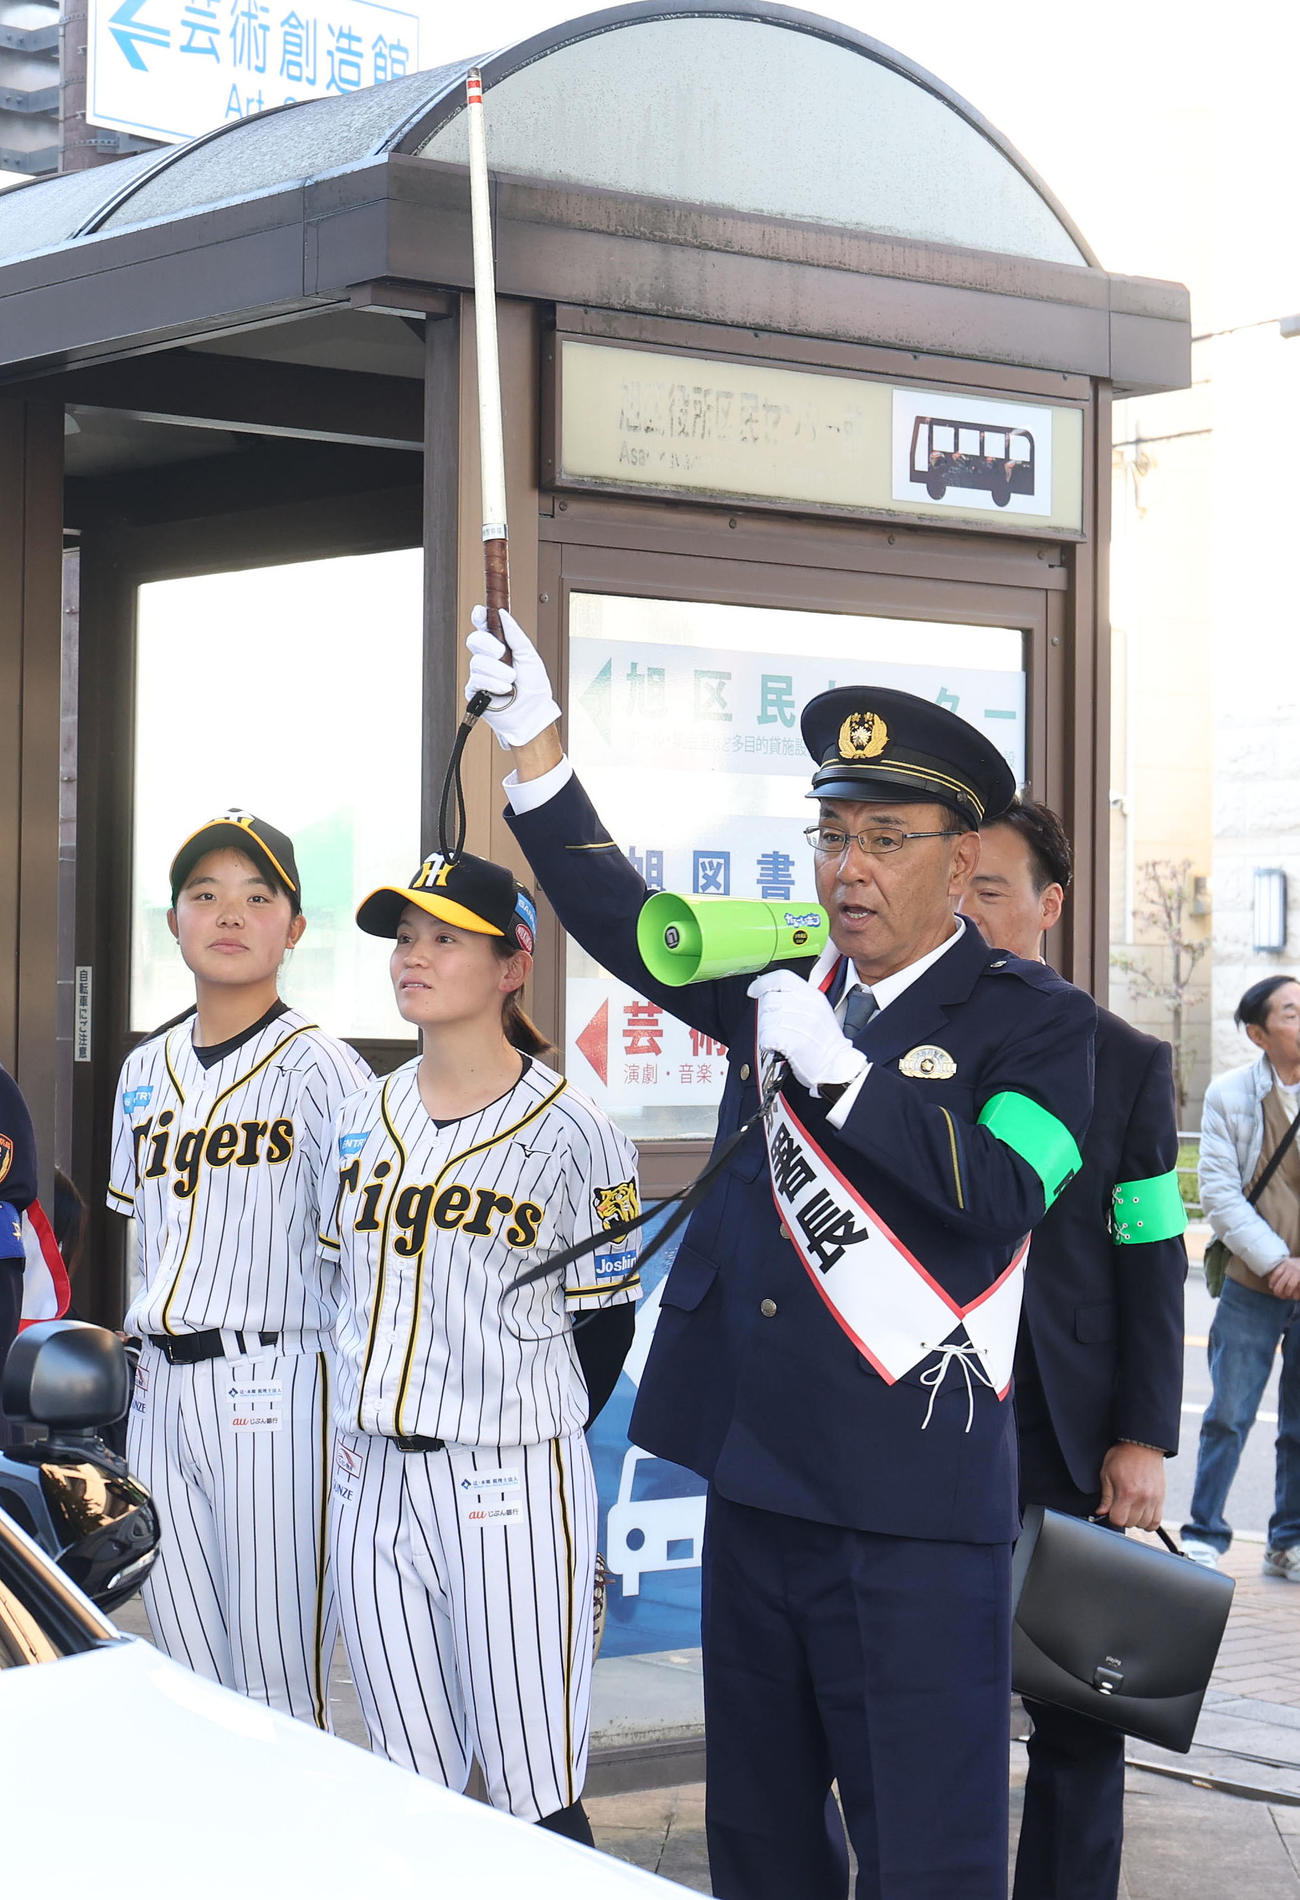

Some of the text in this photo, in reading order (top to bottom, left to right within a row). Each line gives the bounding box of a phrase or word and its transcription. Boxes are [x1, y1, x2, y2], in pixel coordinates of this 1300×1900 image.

[180, 0, 409, 94] 芸術創造館
[134, 1110, 294, 1198] Tigers
[339, 1159, 543, 1257] Tigers
[232, 1417, 249, 1426] au
[468, 1511, 488, 1520] au
